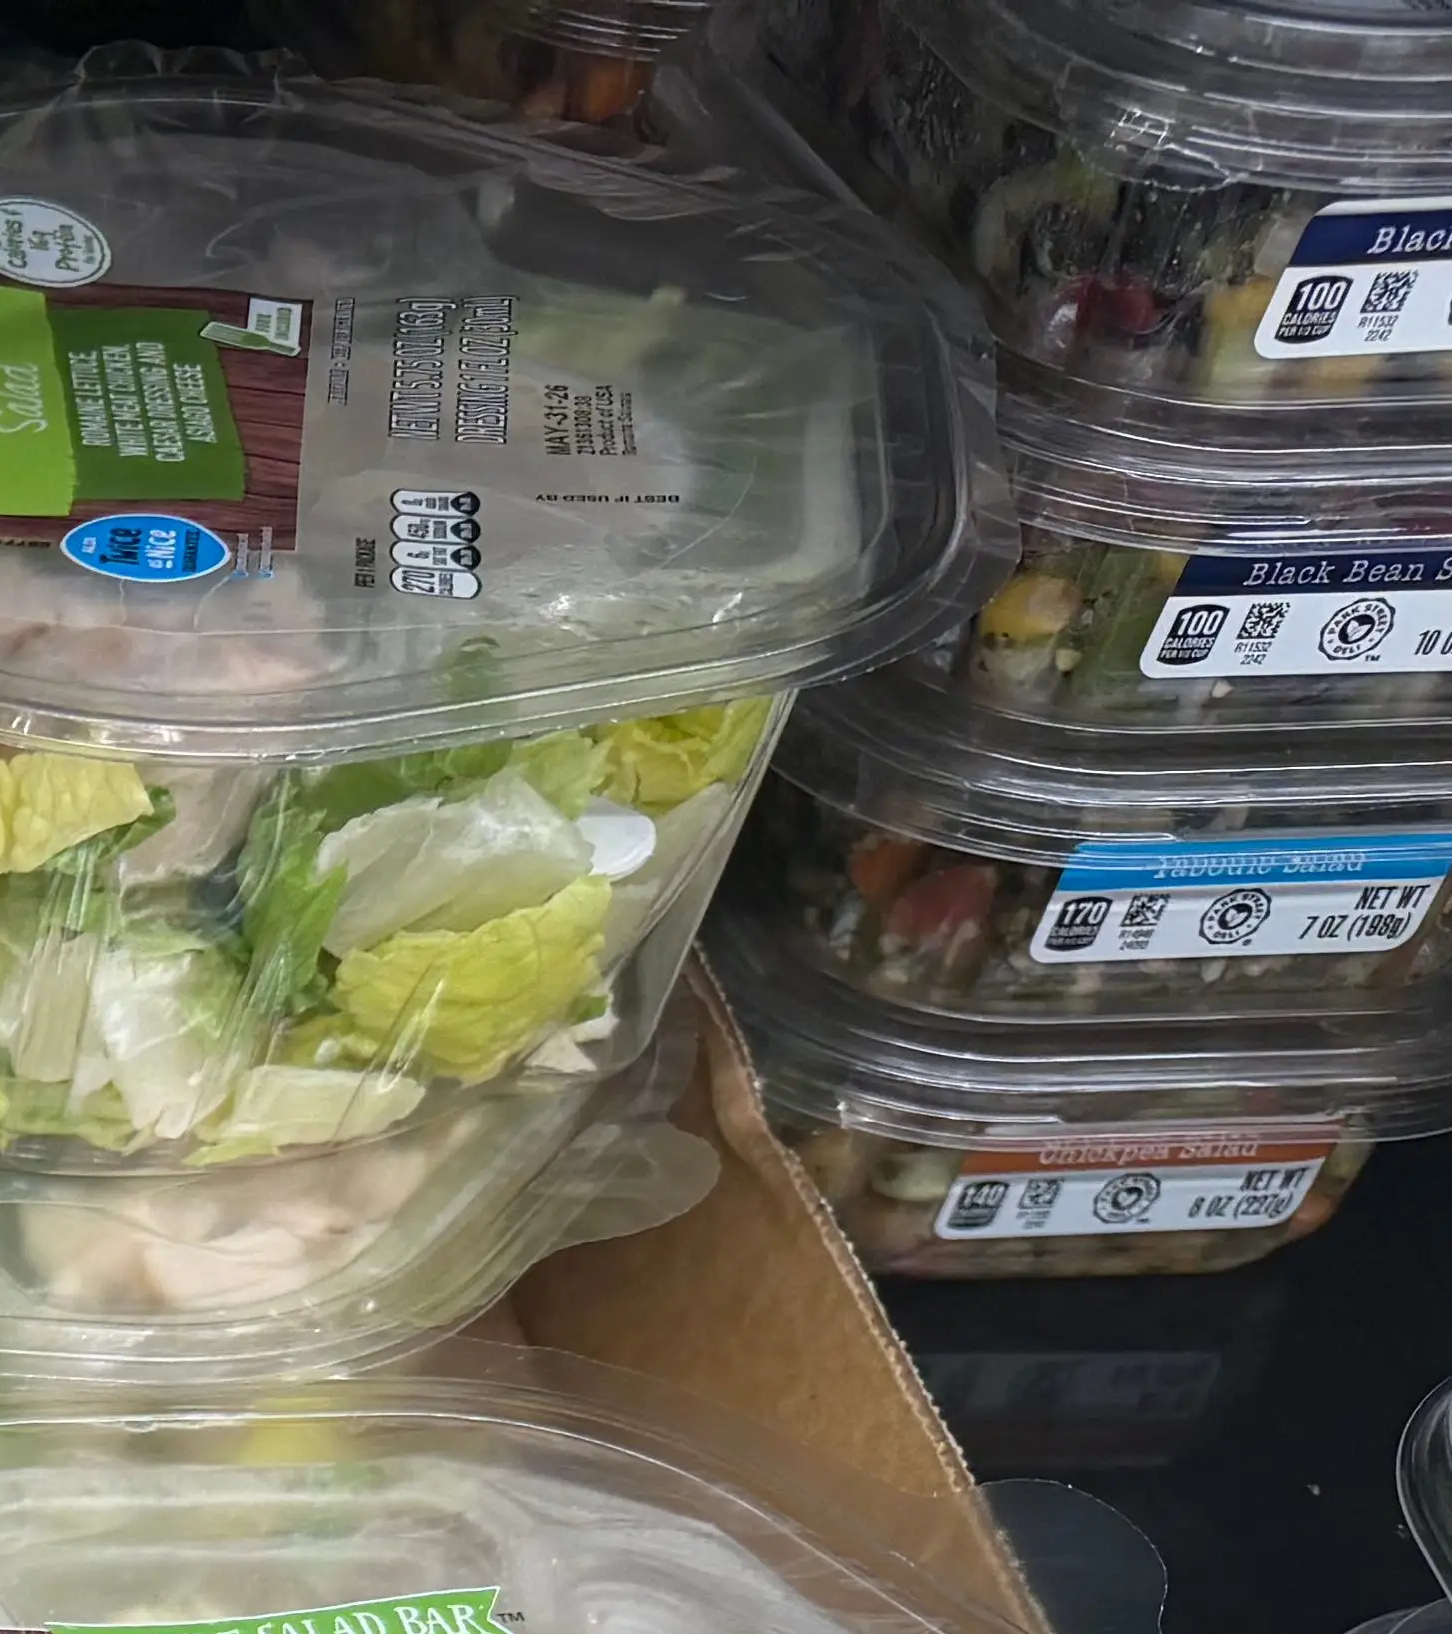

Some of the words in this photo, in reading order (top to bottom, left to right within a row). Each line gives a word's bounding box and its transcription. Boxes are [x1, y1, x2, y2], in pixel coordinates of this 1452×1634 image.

[1295, 280, 1348, 311] 100
[394, 296, 457, 338] (163g)
[460, 294, 521, 338] (30mL)
[1282, 311, 1339, 326] CALORIES
[135, 341, 166, 366] AND
[393, 338, 444, 357] OZ
[459, 337, 510, 358] OZ
[458, 358, 509, 374] FL
[139, 366, 177, 419] DRESSING
[172, 362, 209, 404] CHEESE
[595, 384, 613, 407] USA
[109, 393, 142, 421] MEAT
[390, 391, 442, 413] WT
[455, 383, 509, 444] DRESSING
[75, 396, 112, 446] ROMAINE
[180, 405, 218, 443] ASIAGO
[389, 413, 440, 441] NET
[544, 384, 571, 456] MAY-31-26
[114, 421, 149, 457] WHITE
[149, 420, 185, 462] CAESAR
[98, 527, 143, 565] Twice
[143, 528, 176, 559] Nice
[1242, 561, 1336, 586] Black
[1341, 560, 1425, 583] Bean
[1178, 610, 1224, 636] 100
[1163, 637, 1215, 649] CALORIES
[1413, 630, 1442, 655] 10
[1353, 886, 1397, 910] NET
[1395, 884, 1431, 909] WT
[1062, 900, 1109, 926] 170
[1298, 916, 1320, 939] 7
[1316, 915, 1349, 939] OZ
[1347, 911, 1411, 941] (198g)
[1239, 1168, 1282, 1193] NET
[1278, 1167, 1310, 1190] WT
[1205, 1195, 1234, 1218] OZ
